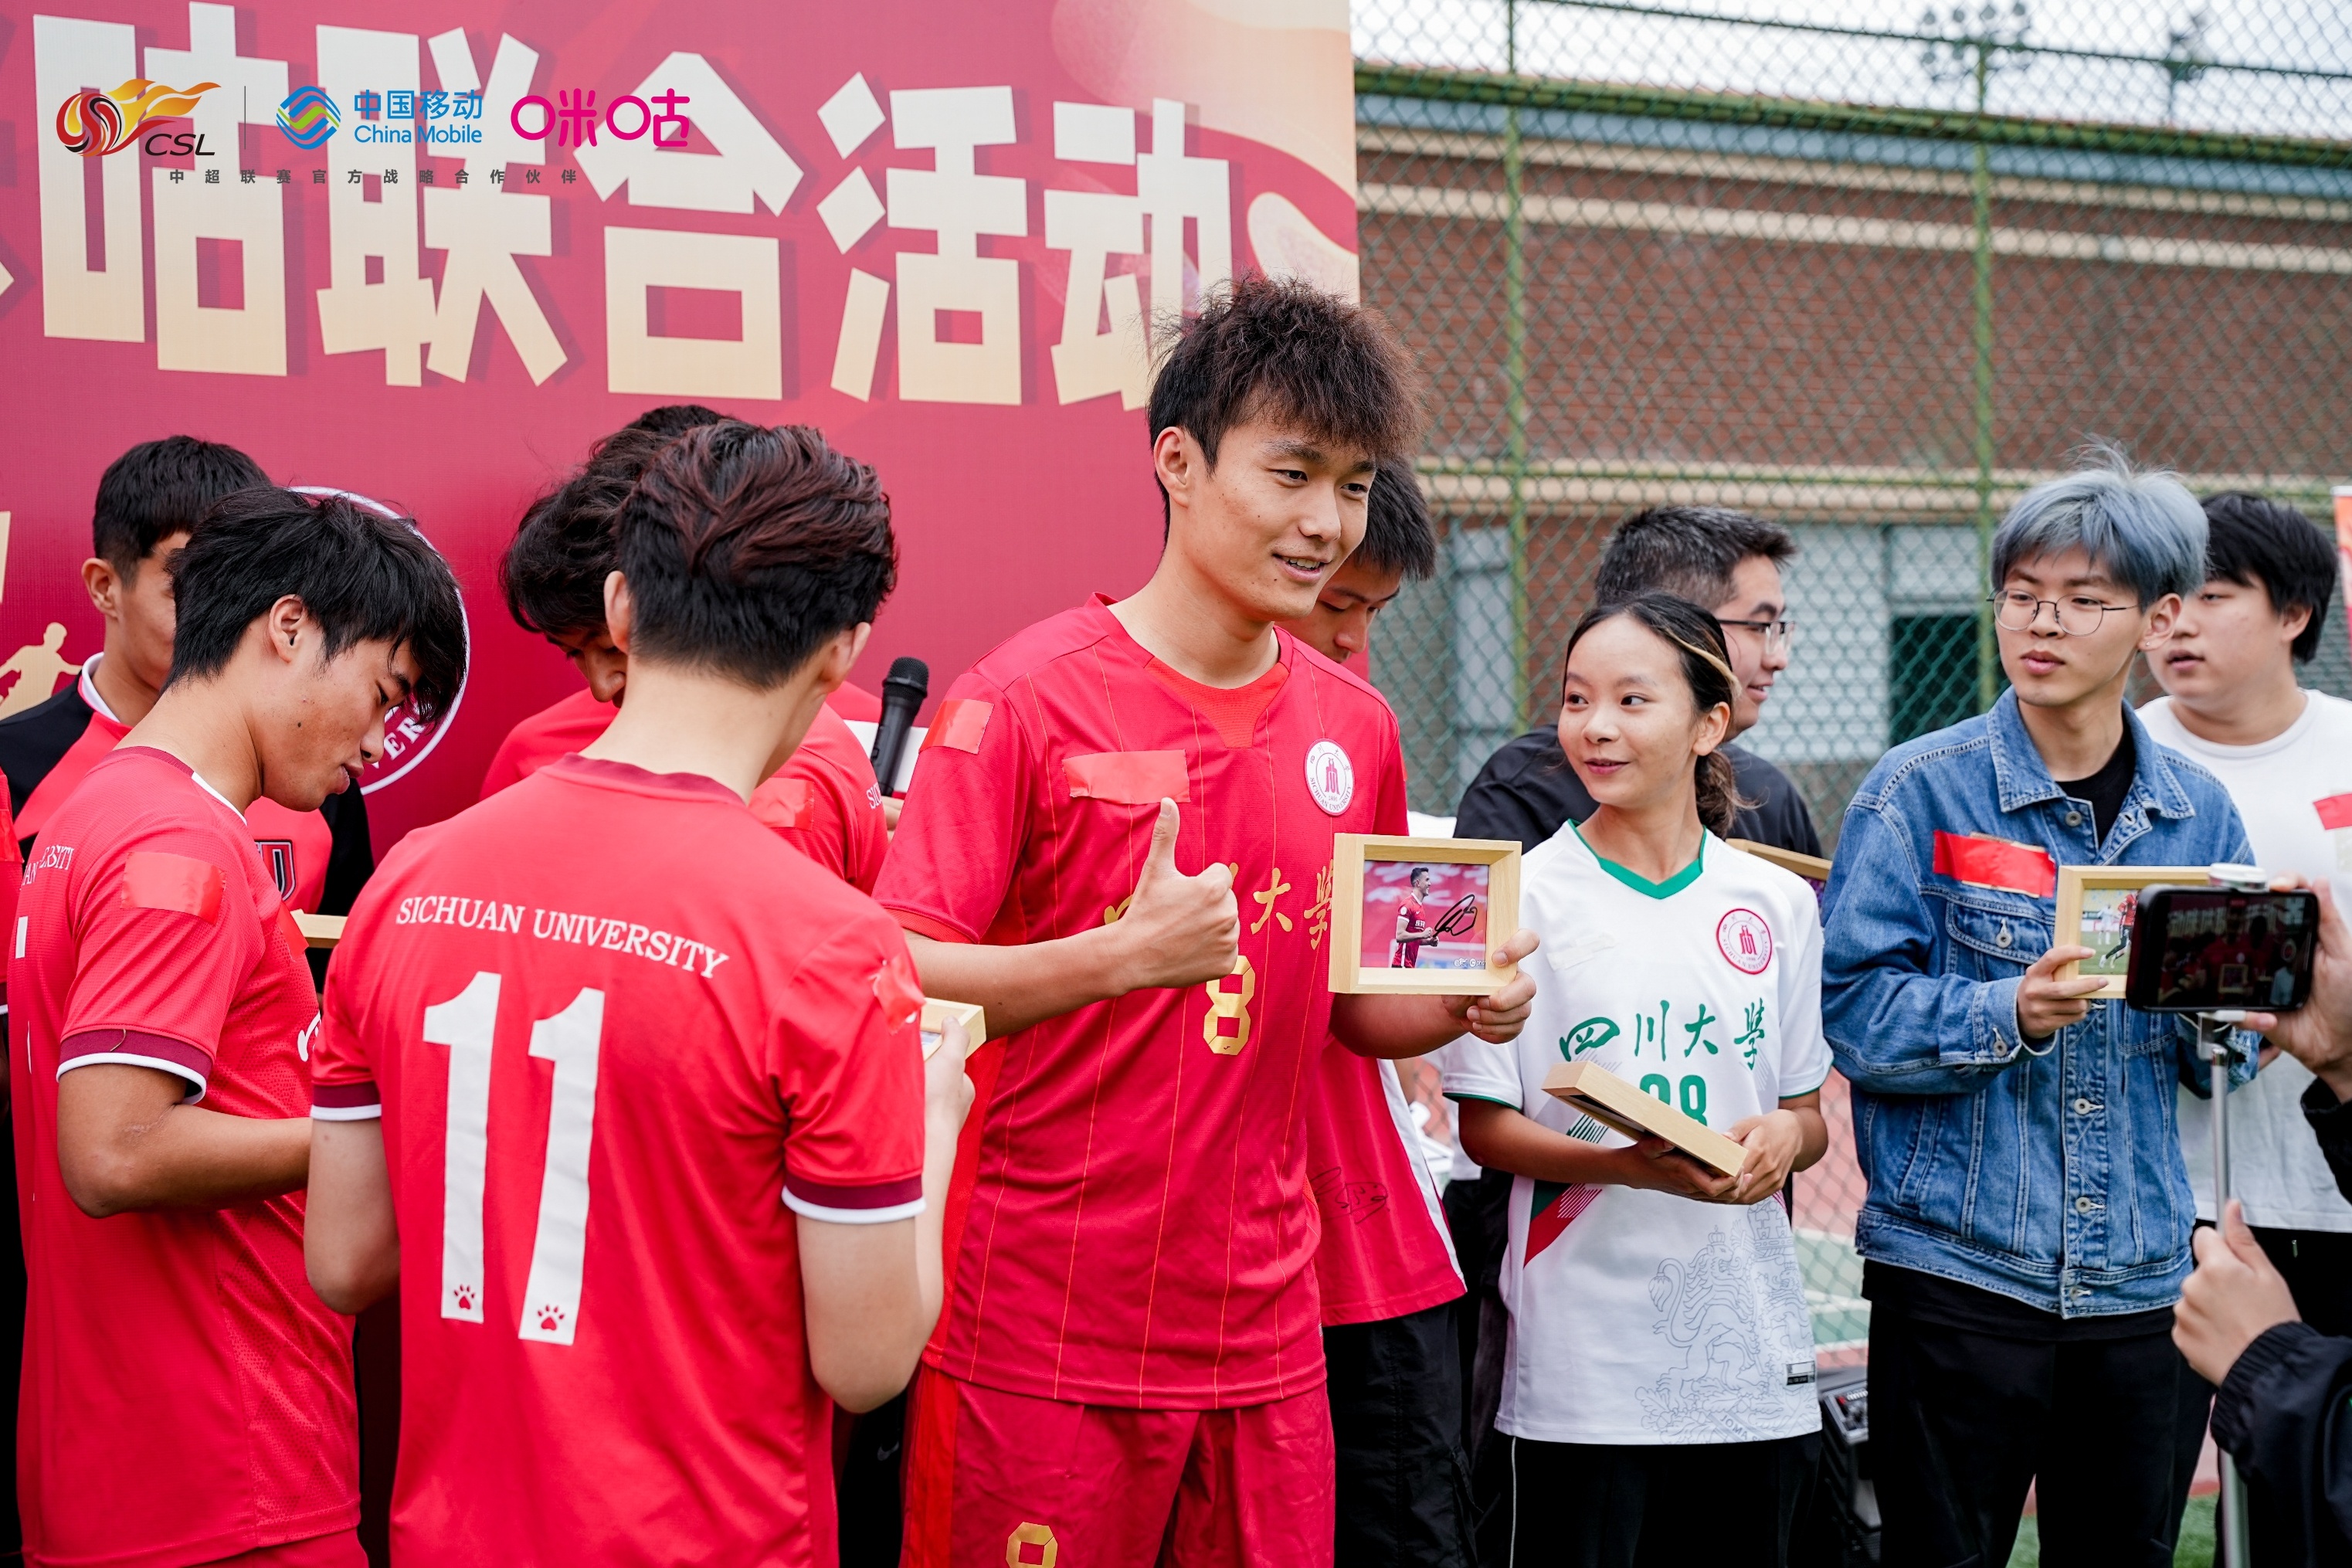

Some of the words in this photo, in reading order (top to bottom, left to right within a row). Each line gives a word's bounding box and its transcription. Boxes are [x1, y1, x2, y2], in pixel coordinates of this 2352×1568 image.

[0, 2, 1234, 411] 咕联合活动
[396, 895, 525, 933] SICHUAN
[533, 908, 729, 979] UNIVERSITY
[1203, 955, 1256, 1056] 8
[423, 971, 606, 1346] 11
[1719, 1414, 1748, 1441] JOMA
